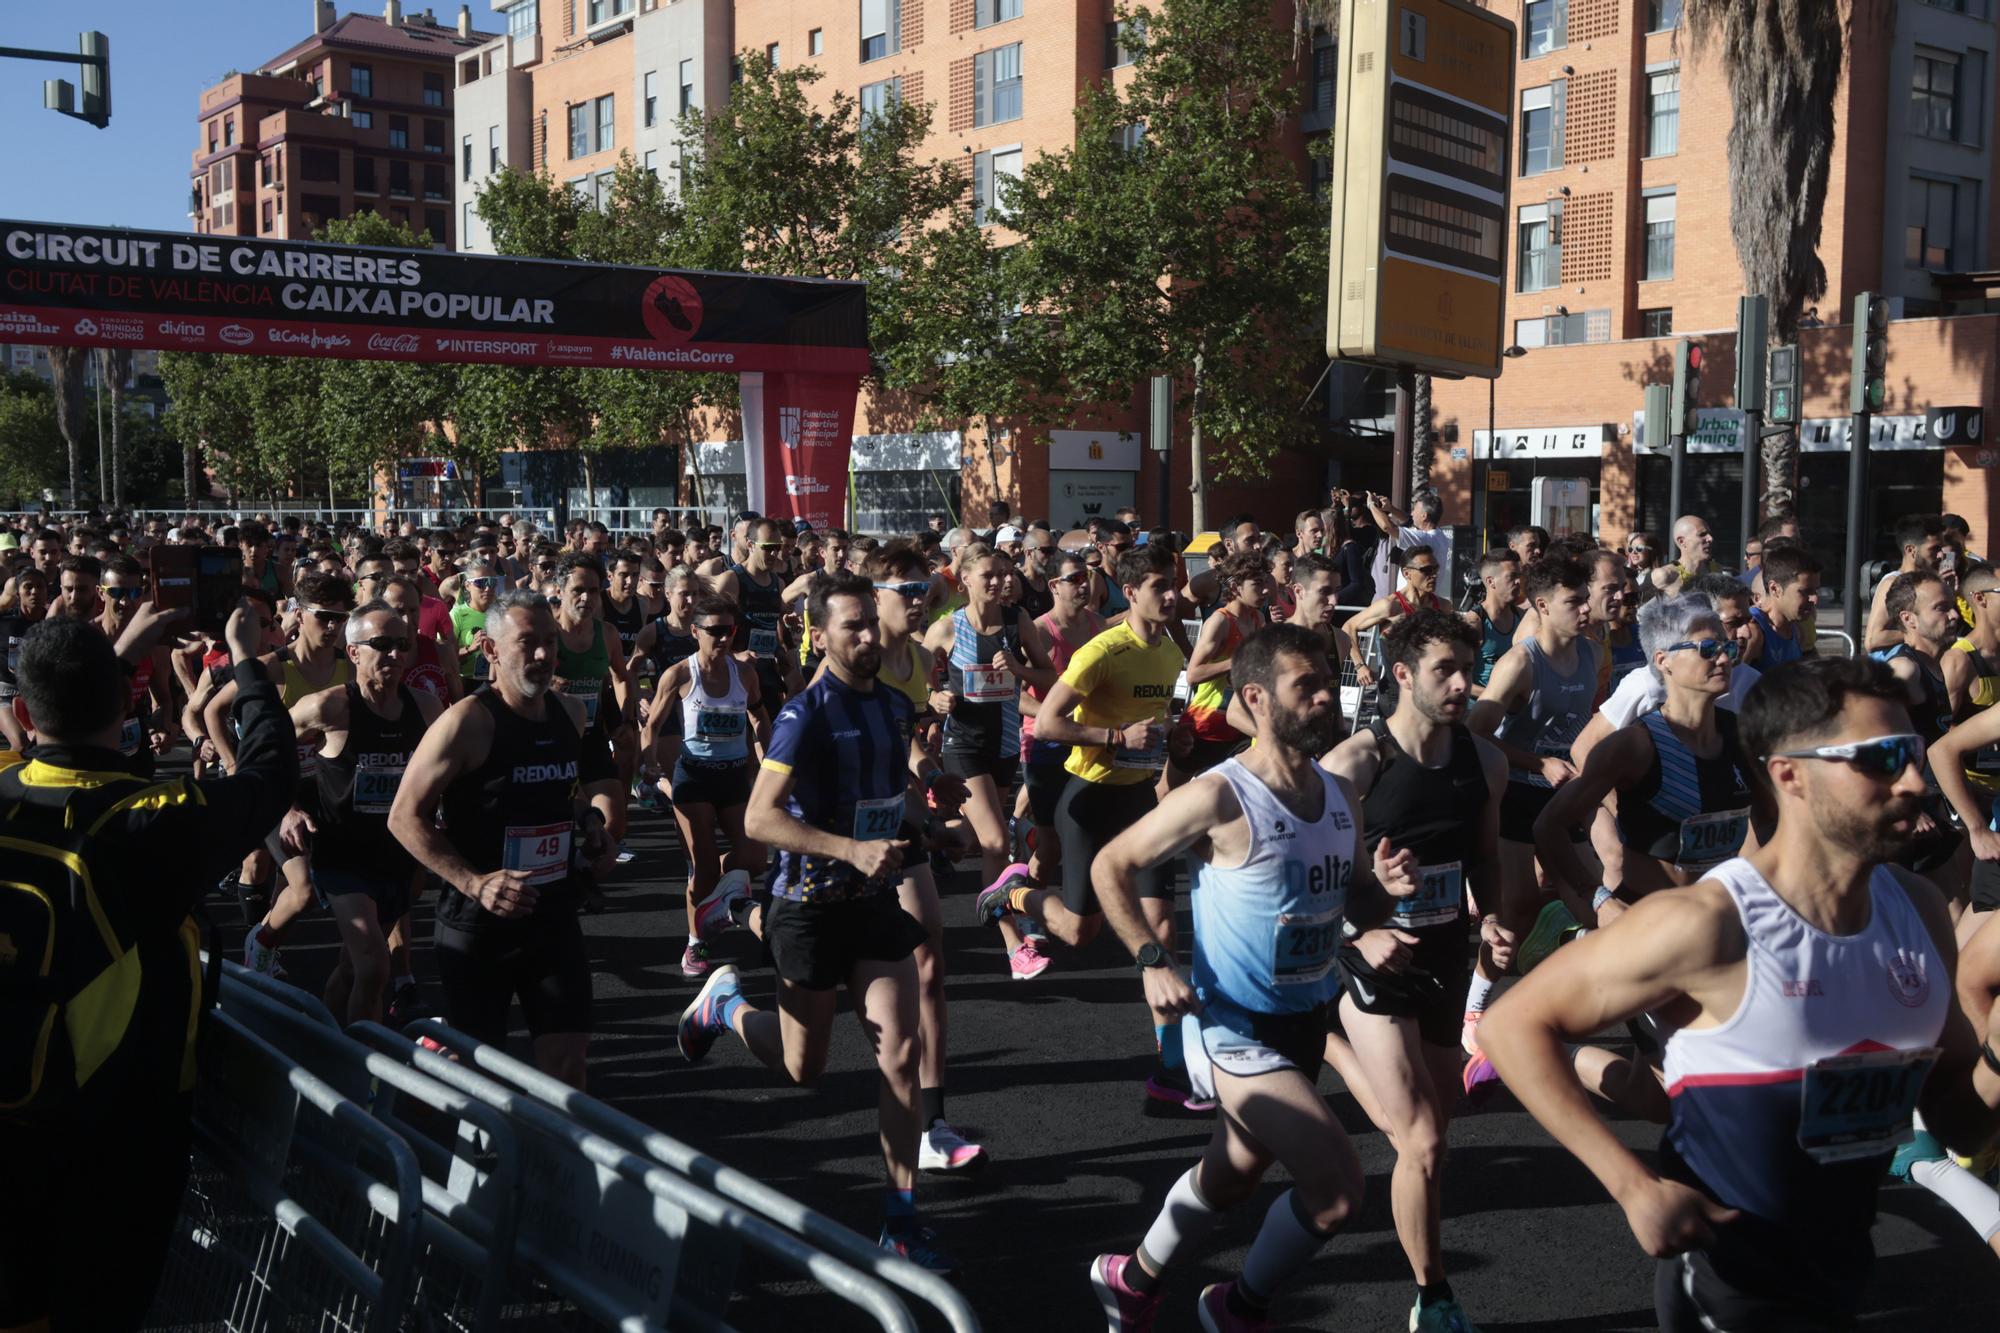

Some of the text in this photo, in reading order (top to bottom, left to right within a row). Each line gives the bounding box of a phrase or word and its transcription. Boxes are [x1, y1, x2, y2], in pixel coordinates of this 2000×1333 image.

[6, 230, 422, 287] CIRCUIT DE CARRERES
[6, 268, 274, 306] CIUTAT DE VALÈNCIA
[281, 282, 555, 324] CAIXA POPULAR
[100, 322, 144, 333] TRINIDAD
[158, 320, 205, 336] divina
[100, 331, 144, 341] ALFONSO
[281, 329, 310, 343] Corte
[451, 340, 537, 355] INTERSPORT
[556, 344, 593, 354] aspaym
[610, 346, 735, 364] #ValènciaCorre
[802, 429, 839, 439] Municipal
[986, 672, 1004, 685] 41
[703, 713, 738, 729] 2326
[535, 836, 560, 857] 49
